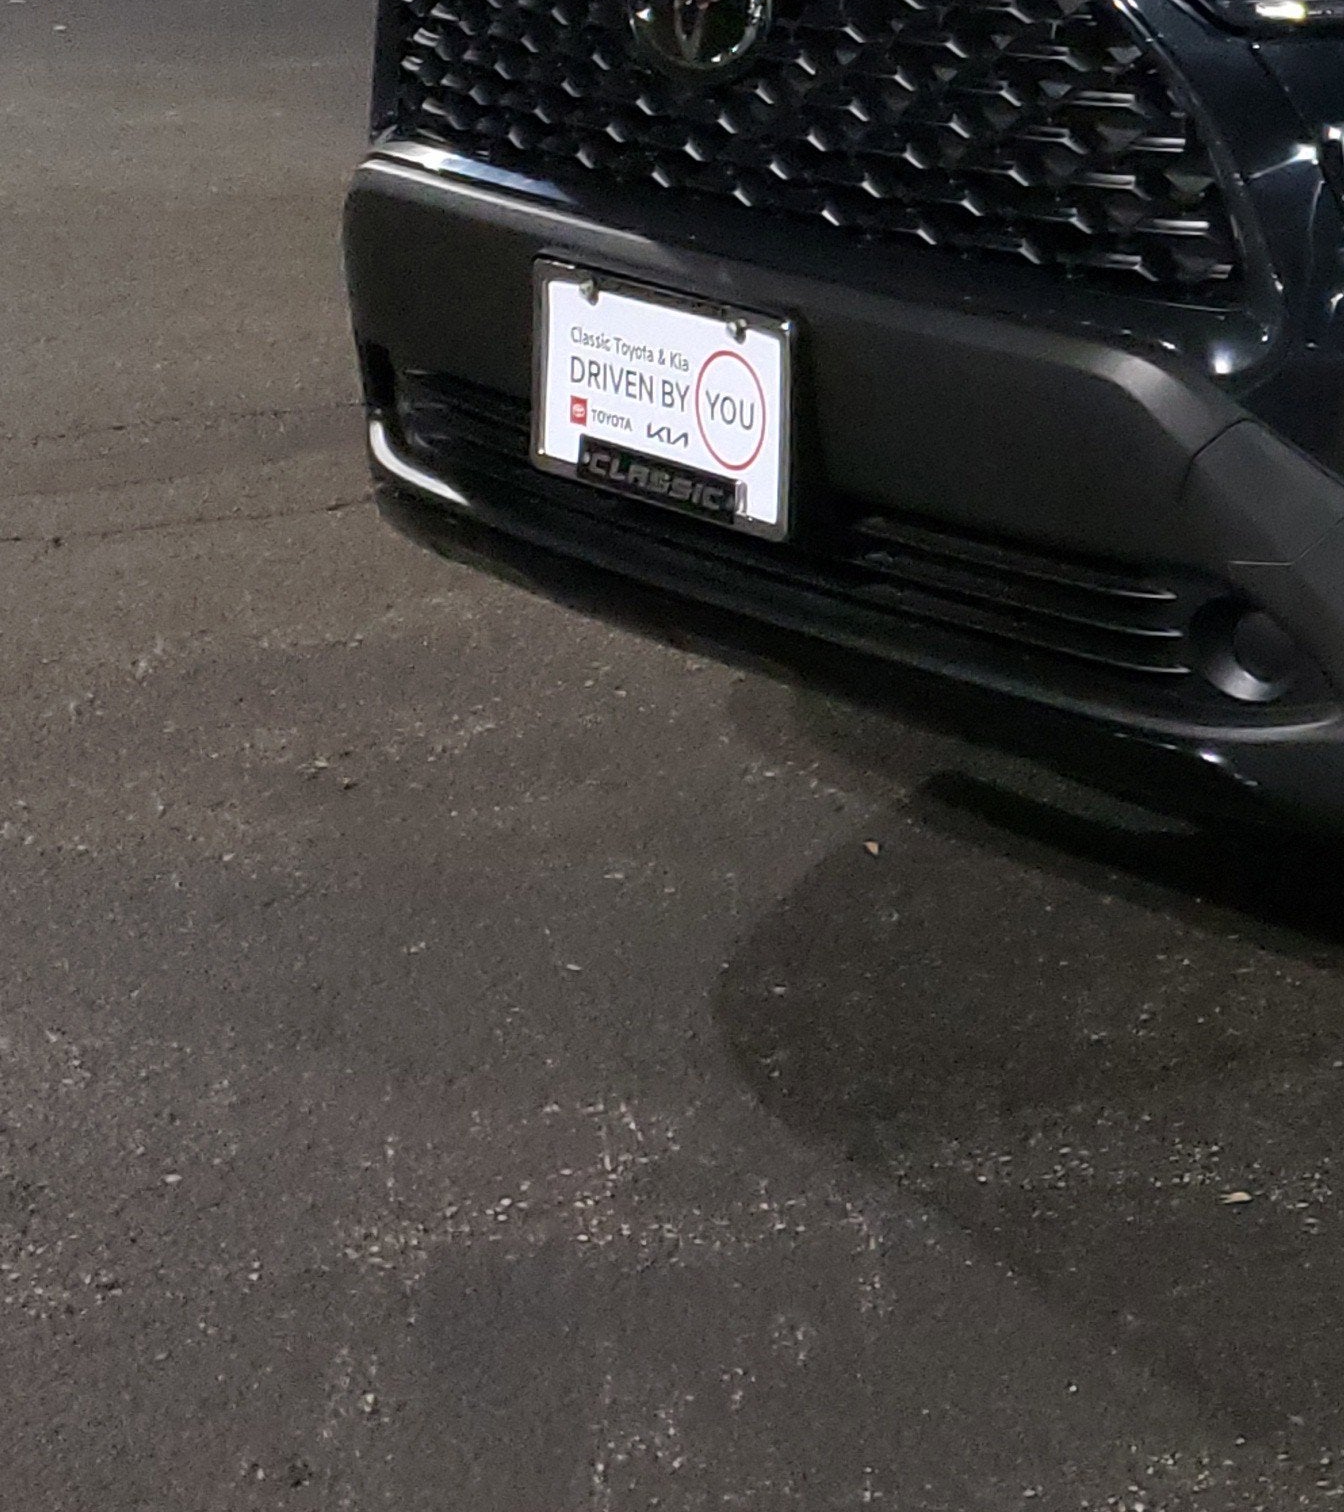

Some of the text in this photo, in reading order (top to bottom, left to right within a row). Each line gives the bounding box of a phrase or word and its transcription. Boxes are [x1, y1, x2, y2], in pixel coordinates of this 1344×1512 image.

[570, 325, 690, 372] Classic Toyota & Kia
[569, 355, 755, 431] DRIVEN BY YOU
[591, 408, 633, 432] TOYOTA
[588, 451, 725, 511] CLASSIC
